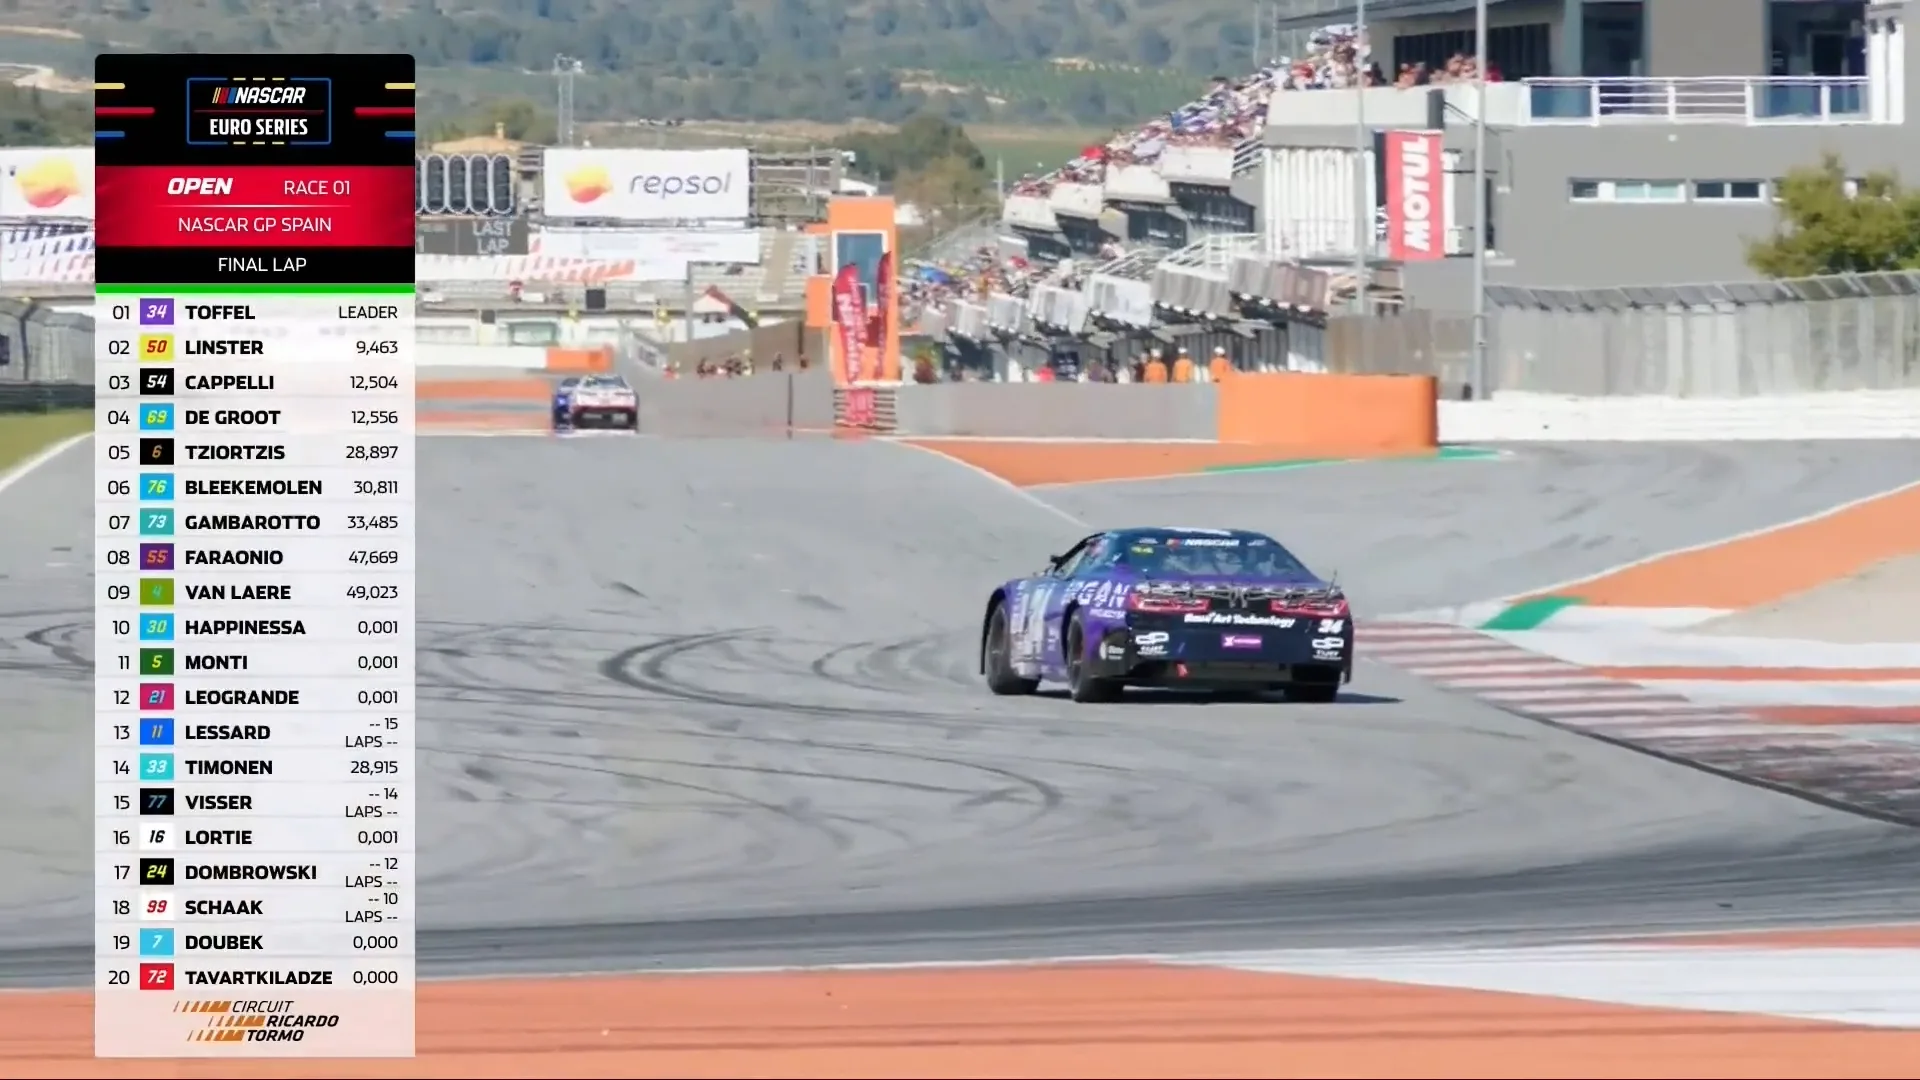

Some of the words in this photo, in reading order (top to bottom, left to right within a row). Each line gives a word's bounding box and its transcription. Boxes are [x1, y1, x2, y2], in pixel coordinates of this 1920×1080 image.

[629, 171, 732, 200] repsol
[1401, 137, 1431, 252] MOTUL
[472, 220, 513, 237] LAST
[477, 237, 510, 254] LAP
